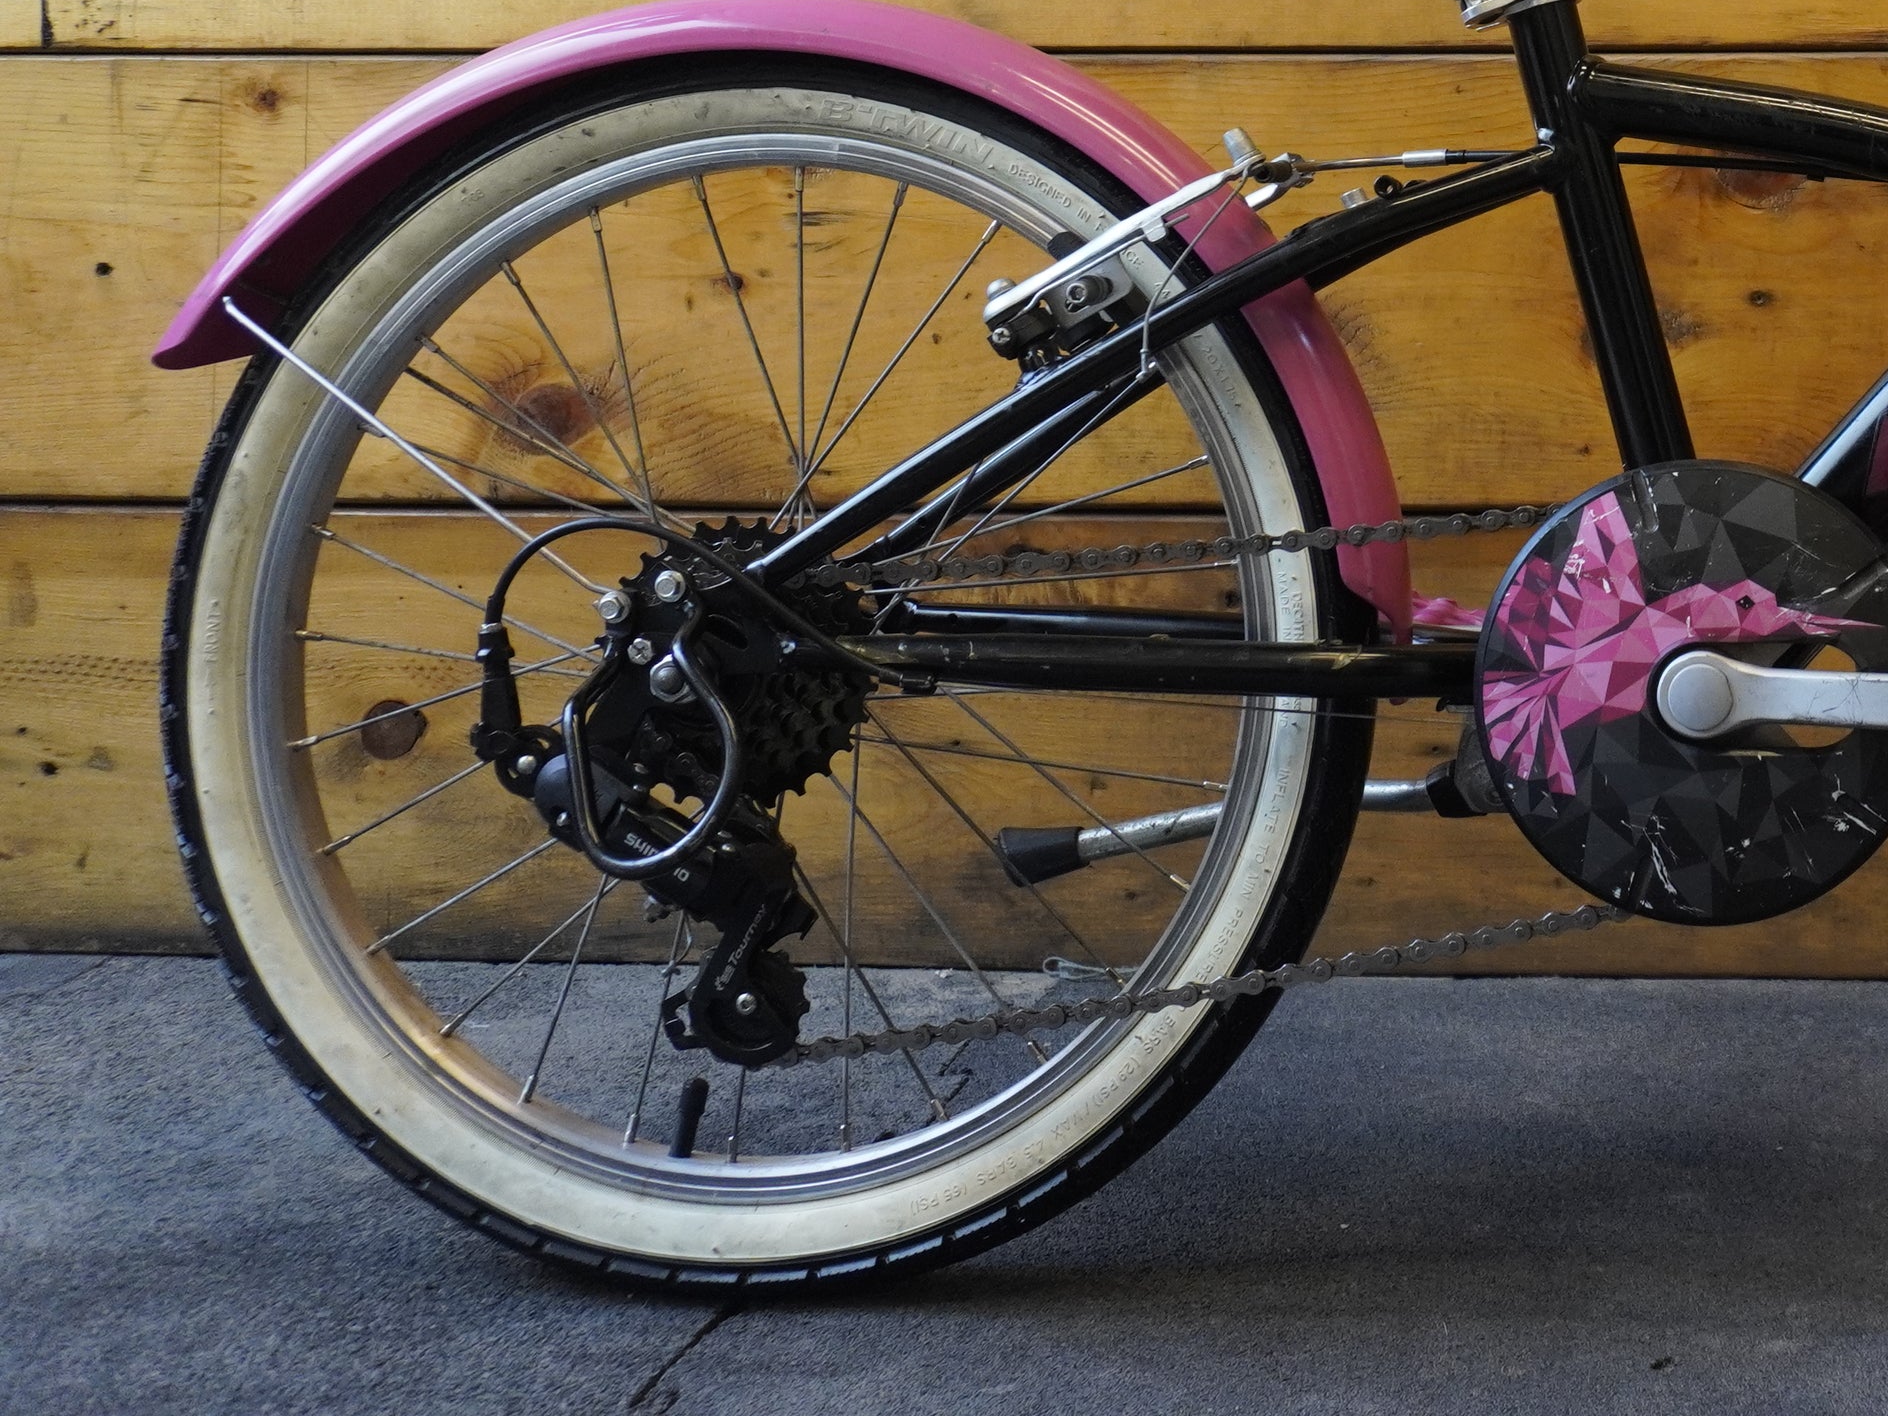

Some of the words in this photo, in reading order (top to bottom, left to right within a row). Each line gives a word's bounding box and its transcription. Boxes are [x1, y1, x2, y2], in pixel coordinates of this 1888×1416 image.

[1006, 159, 1075, 212] DESIGNED
[1074, 205, 1094, 225] IN
[1275, 569, 1293, 614] MADE
[1262, 766, 1291, 836] INFLATE
[624, 832, 690, 883] SHIO
[1252, 840, 1271, 867] TO
[1238, 870, 1261, 902] MIN
[1191, 904, 1245, 985] PRESSURE
[1138, 1012, 1178, 1057] BARS
[973, 1153, 1019, 1188] BARS
